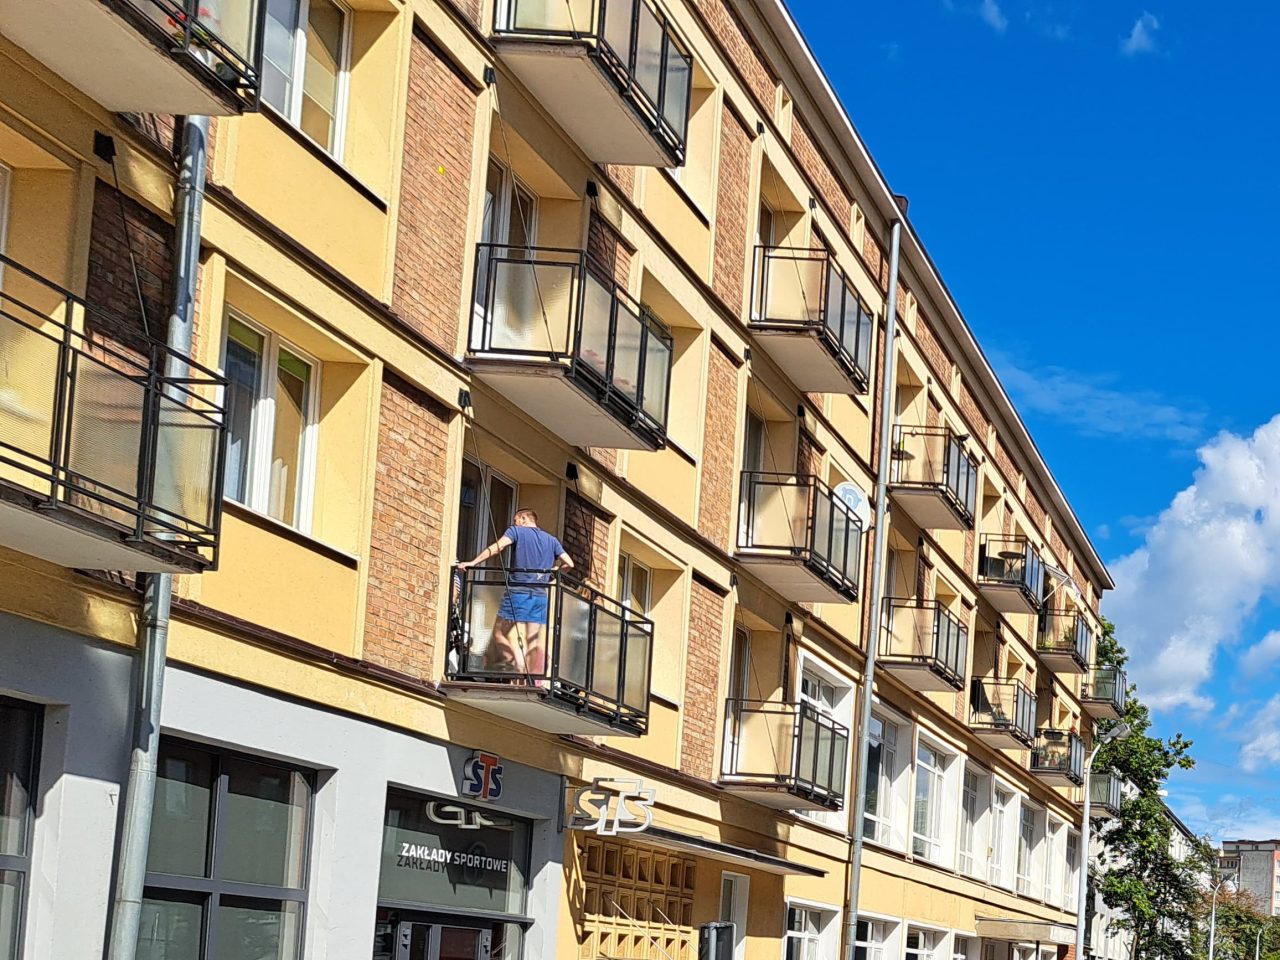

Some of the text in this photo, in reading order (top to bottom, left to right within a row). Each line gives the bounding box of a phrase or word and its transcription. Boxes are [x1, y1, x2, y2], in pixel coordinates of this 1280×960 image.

[465, 752, 504, 799] STS
[571, 777, 656, 836] STS
[402, 843, 507, 872] ZAKŁADY SPORTOWE
